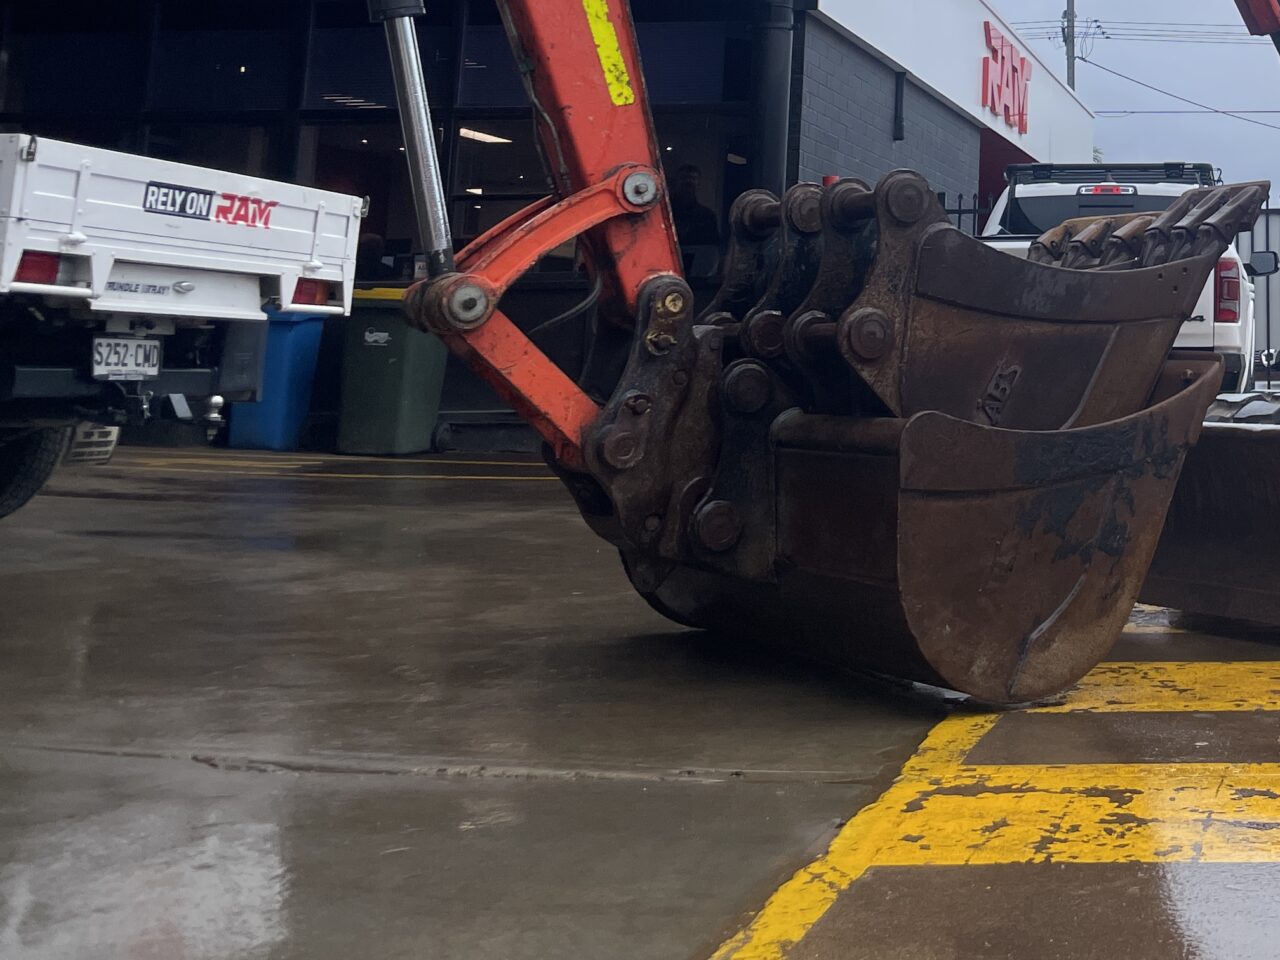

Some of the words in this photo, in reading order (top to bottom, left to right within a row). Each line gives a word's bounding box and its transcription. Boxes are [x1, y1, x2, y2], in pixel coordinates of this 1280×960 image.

[982, 21, 1032, 135] RAM
[145, 185, 186, 213] RELY
[185, 192, 210, 216] ON
[215, 192, 279, 229] RAM
